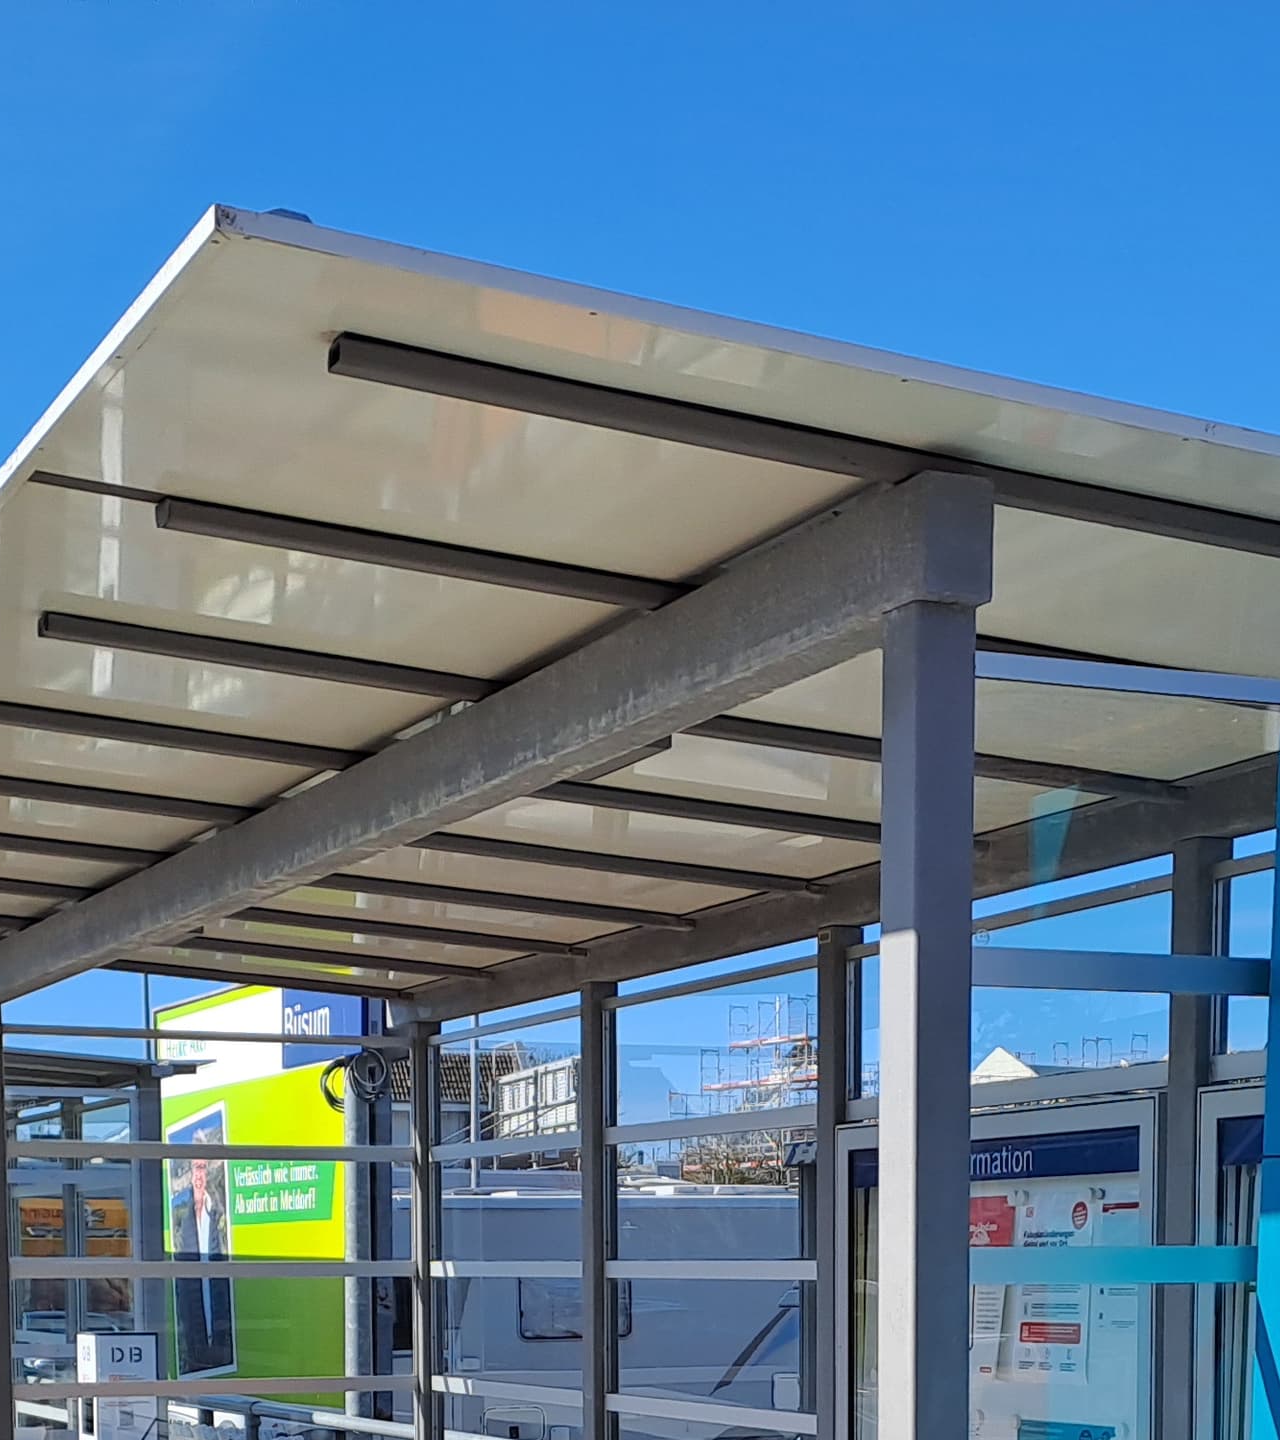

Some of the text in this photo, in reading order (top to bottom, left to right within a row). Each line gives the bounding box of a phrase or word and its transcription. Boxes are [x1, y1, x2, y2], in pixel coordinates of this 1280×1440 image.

[284, 1003, 330, 1036] Büsum
[969, 1144, 1033, 1176] rmation
[233, 1162, 319, 1187] Verlässlich wie immer.
[234, 1187, 317, 1214] Ab sofort in Meldorf!
[111, 1346, 143, 1363] DB
